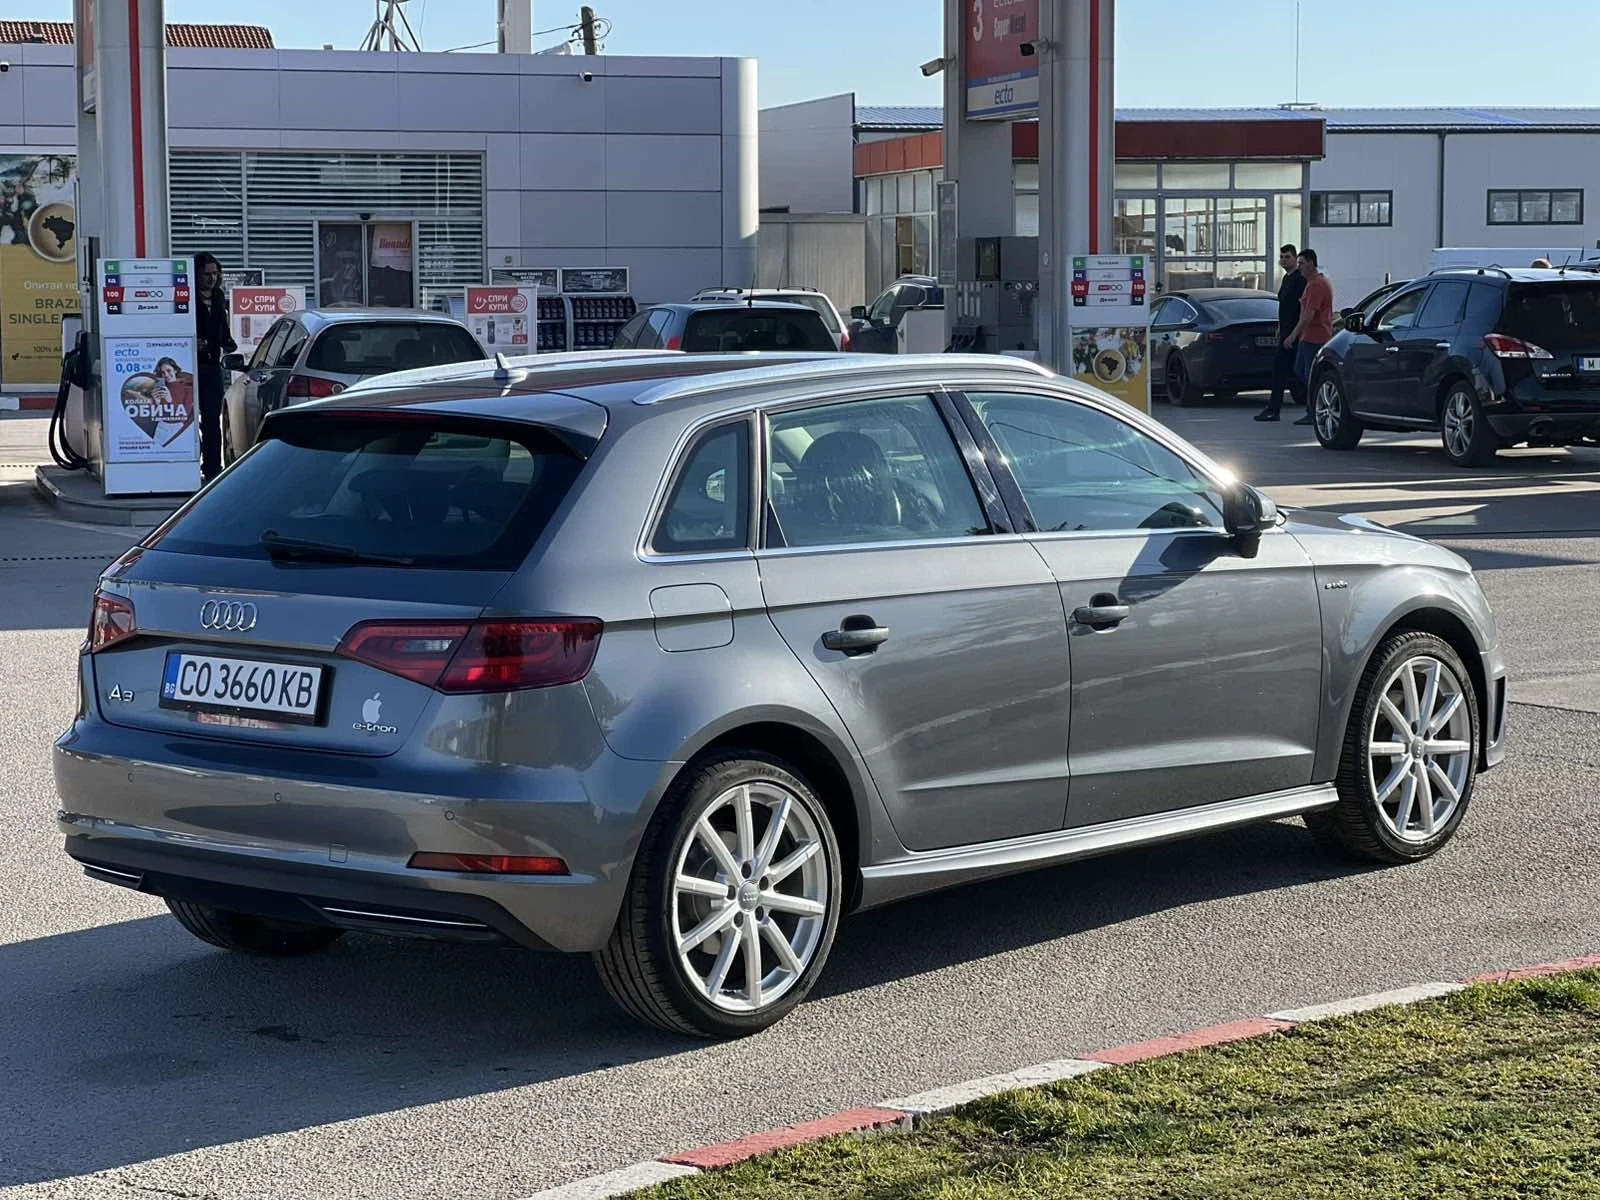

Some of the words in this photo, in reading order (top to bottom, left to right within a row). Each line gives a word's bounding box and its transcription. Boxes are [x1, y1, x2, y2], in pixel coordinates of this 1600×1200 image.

[994, 84, 1014, 104] ecto
[254, 295, 275, 303] СПРИ
[488, 294, 508, 303] СПРИ
[254, 304, 275, 312] КУПИ
[488, 304, 508, 312] КУПИ
[8, 313, 60, 325] SINGLE
[115, 348, 140, 357] ecto
[115, 362, 141, 374] 0,08
[126, 403, 188, 418] ОБИЧА
[164, 682, 176, 695] BG
[180, 660, 212, 697] CO
[214, 663, 276, 704] 3660
[278, 669, 314, 709] KB
[108, 683, 134, 702] A3
[352, 722, 398, 734] e-tron
